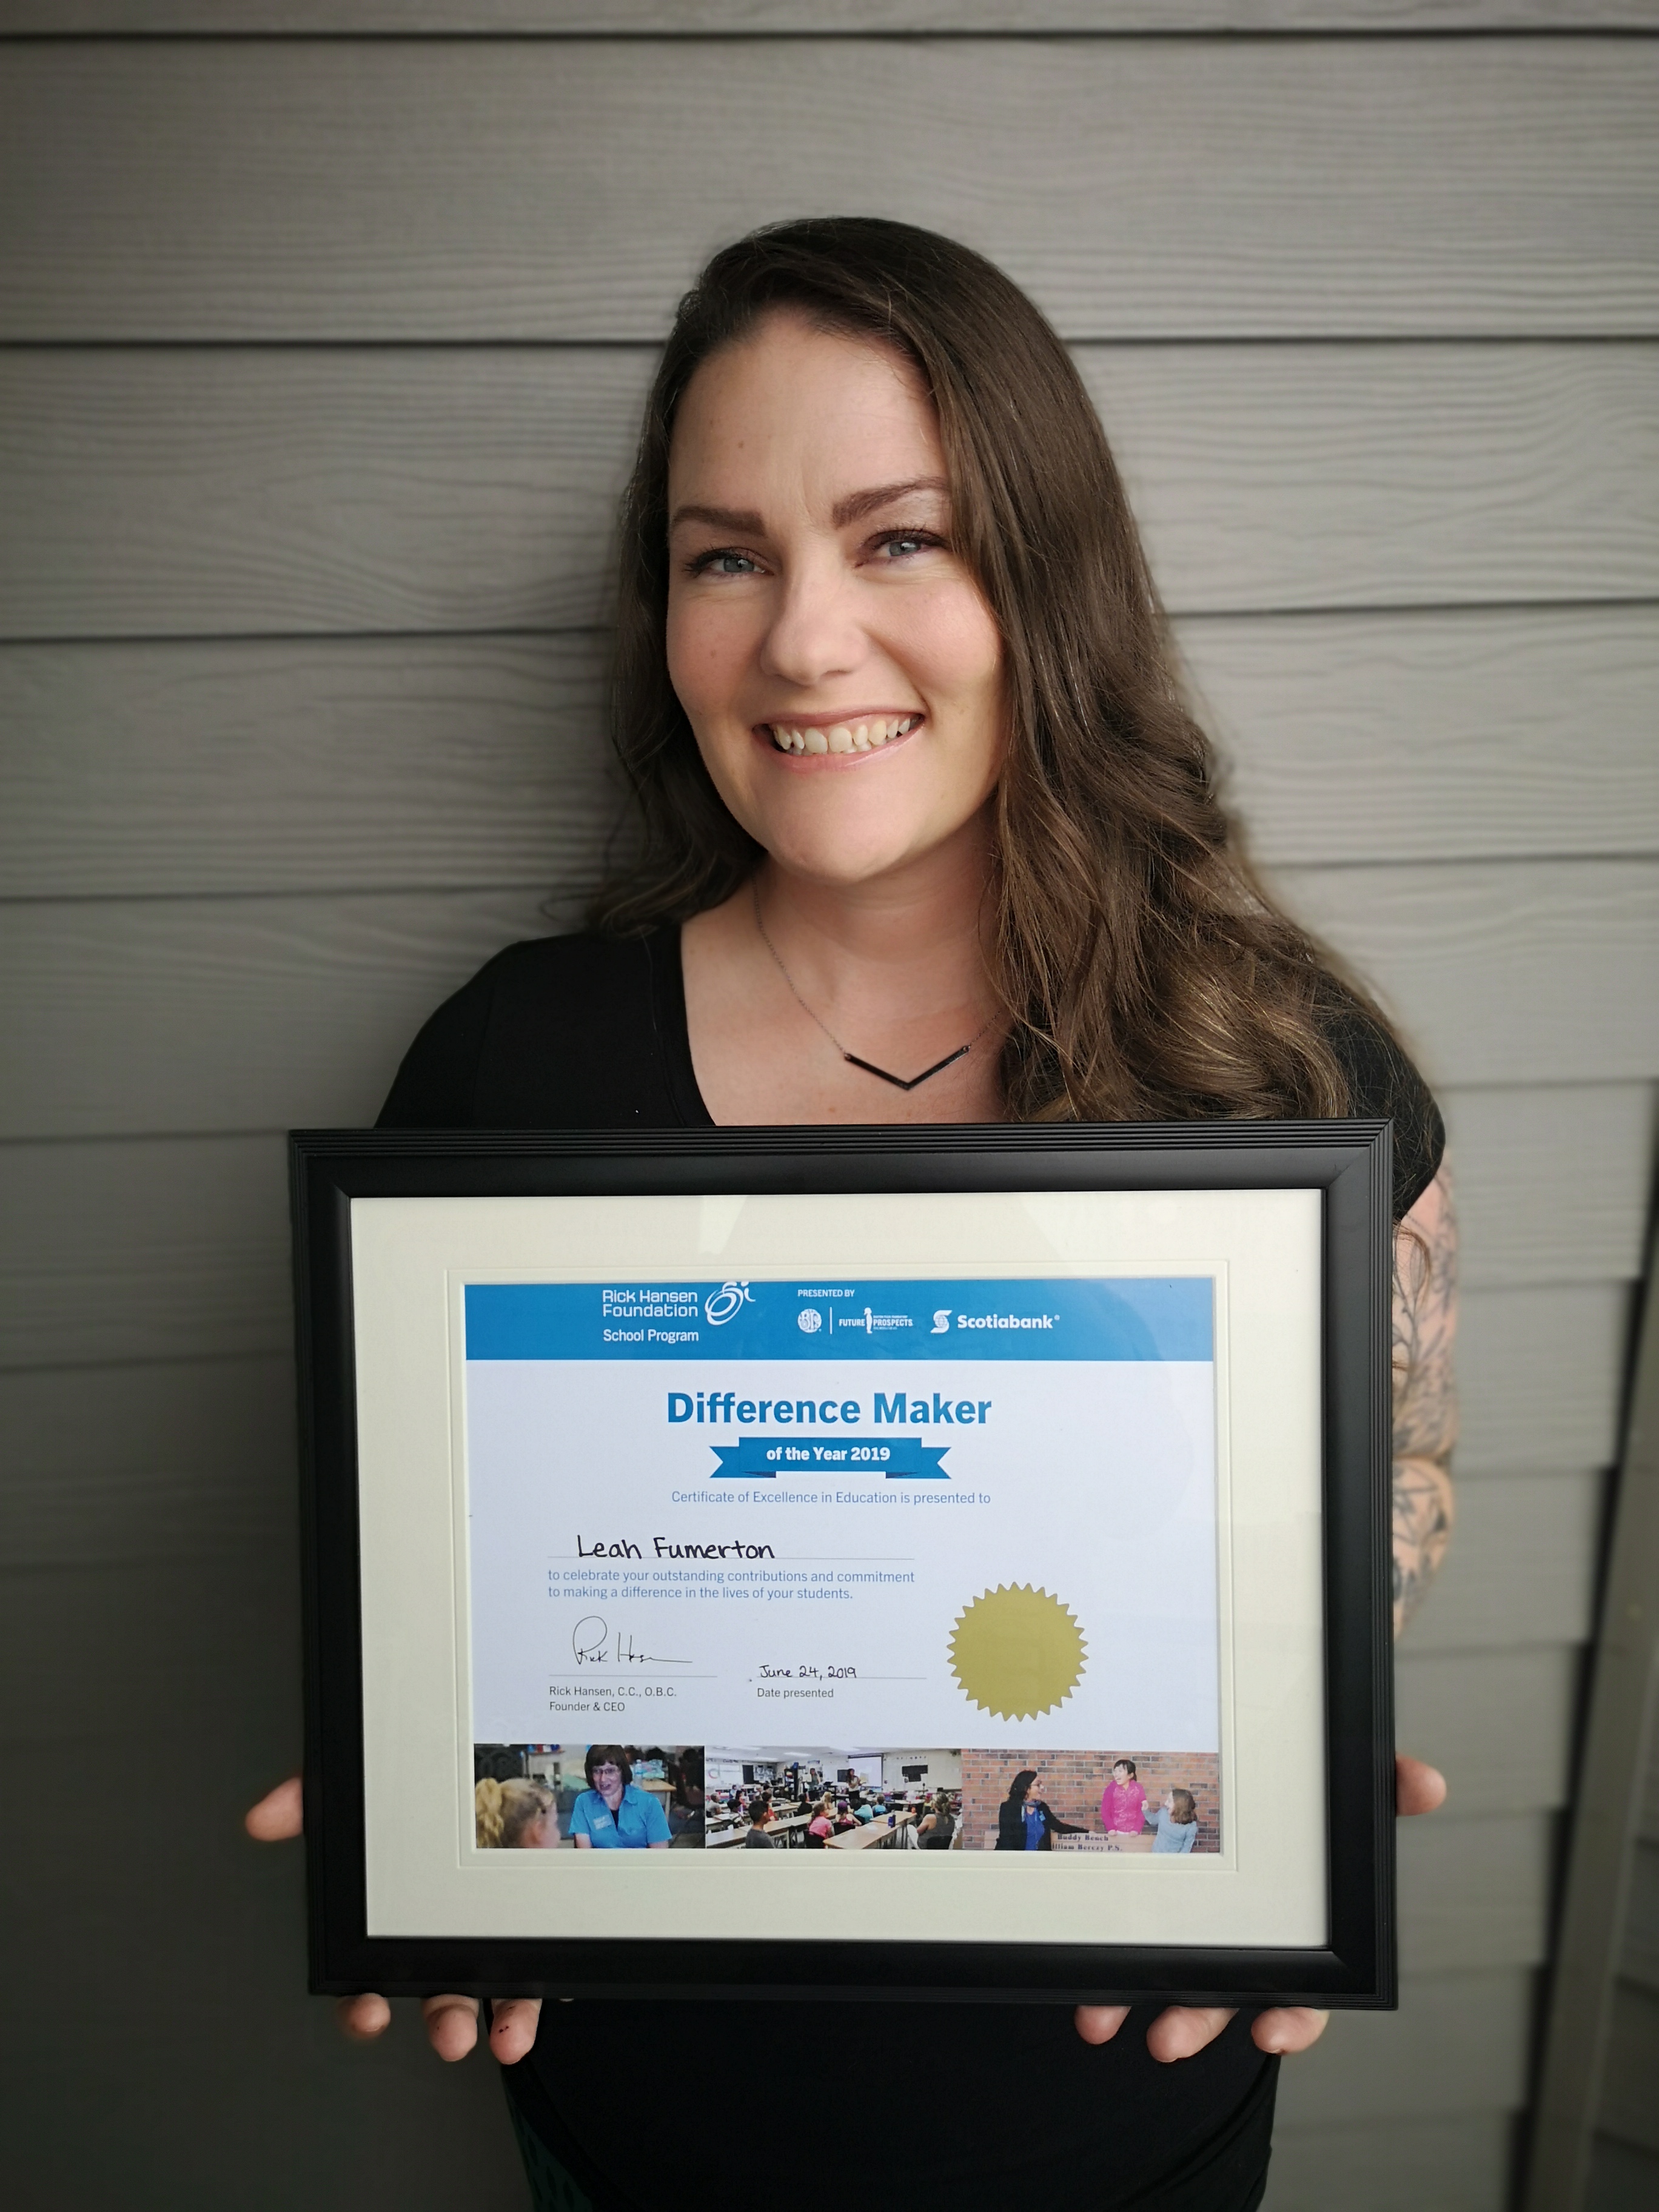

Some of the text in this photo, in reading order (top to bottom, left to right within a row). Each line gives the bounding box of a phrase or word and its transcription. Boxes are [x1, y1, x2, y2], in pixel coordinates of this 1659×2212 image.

[603, 1290, 697, 1303] Rick Hansen
[603, 1304, 698, 1316] Foundation
[873, 1318, 913, 1327] PROSPECTS
[603, 1329, 699, 1344] School Program
[668, 1392, 991, 1424] Difference Maker
[766, 1447, 890, 1461] of the Year 2019
[672, 1491, 990, 1505] Certificate of Excellence in Education is presented to
[577, 1535, 776, 1560] Leah Fumerton
[548, 1569, 914, 1583] to celebrate your outstanding contributions and commitment
[549, 1587, 560, 1597] to
[564, 1586, 608, 1599] making
[622, 1586, 682, 1597] difference
[686, 1587, 695, 1597] in
[700, 1587, 719, 1598] the
[723, 1587, 749, 1598] lives
[752, 1587, 764, 1598] of
[768, 1590, 793, 1600] your
[797, 1588, 853, 1598] students.
[758, 1664, 857, 1680] June 24, 2019
[550, 1686, 676, 1697] Rick Hansen, C.C., O.B.C.
[757, 1688, 833, 1698] Date presented
[550, 1701, 625, 1711] Founder & CEO
